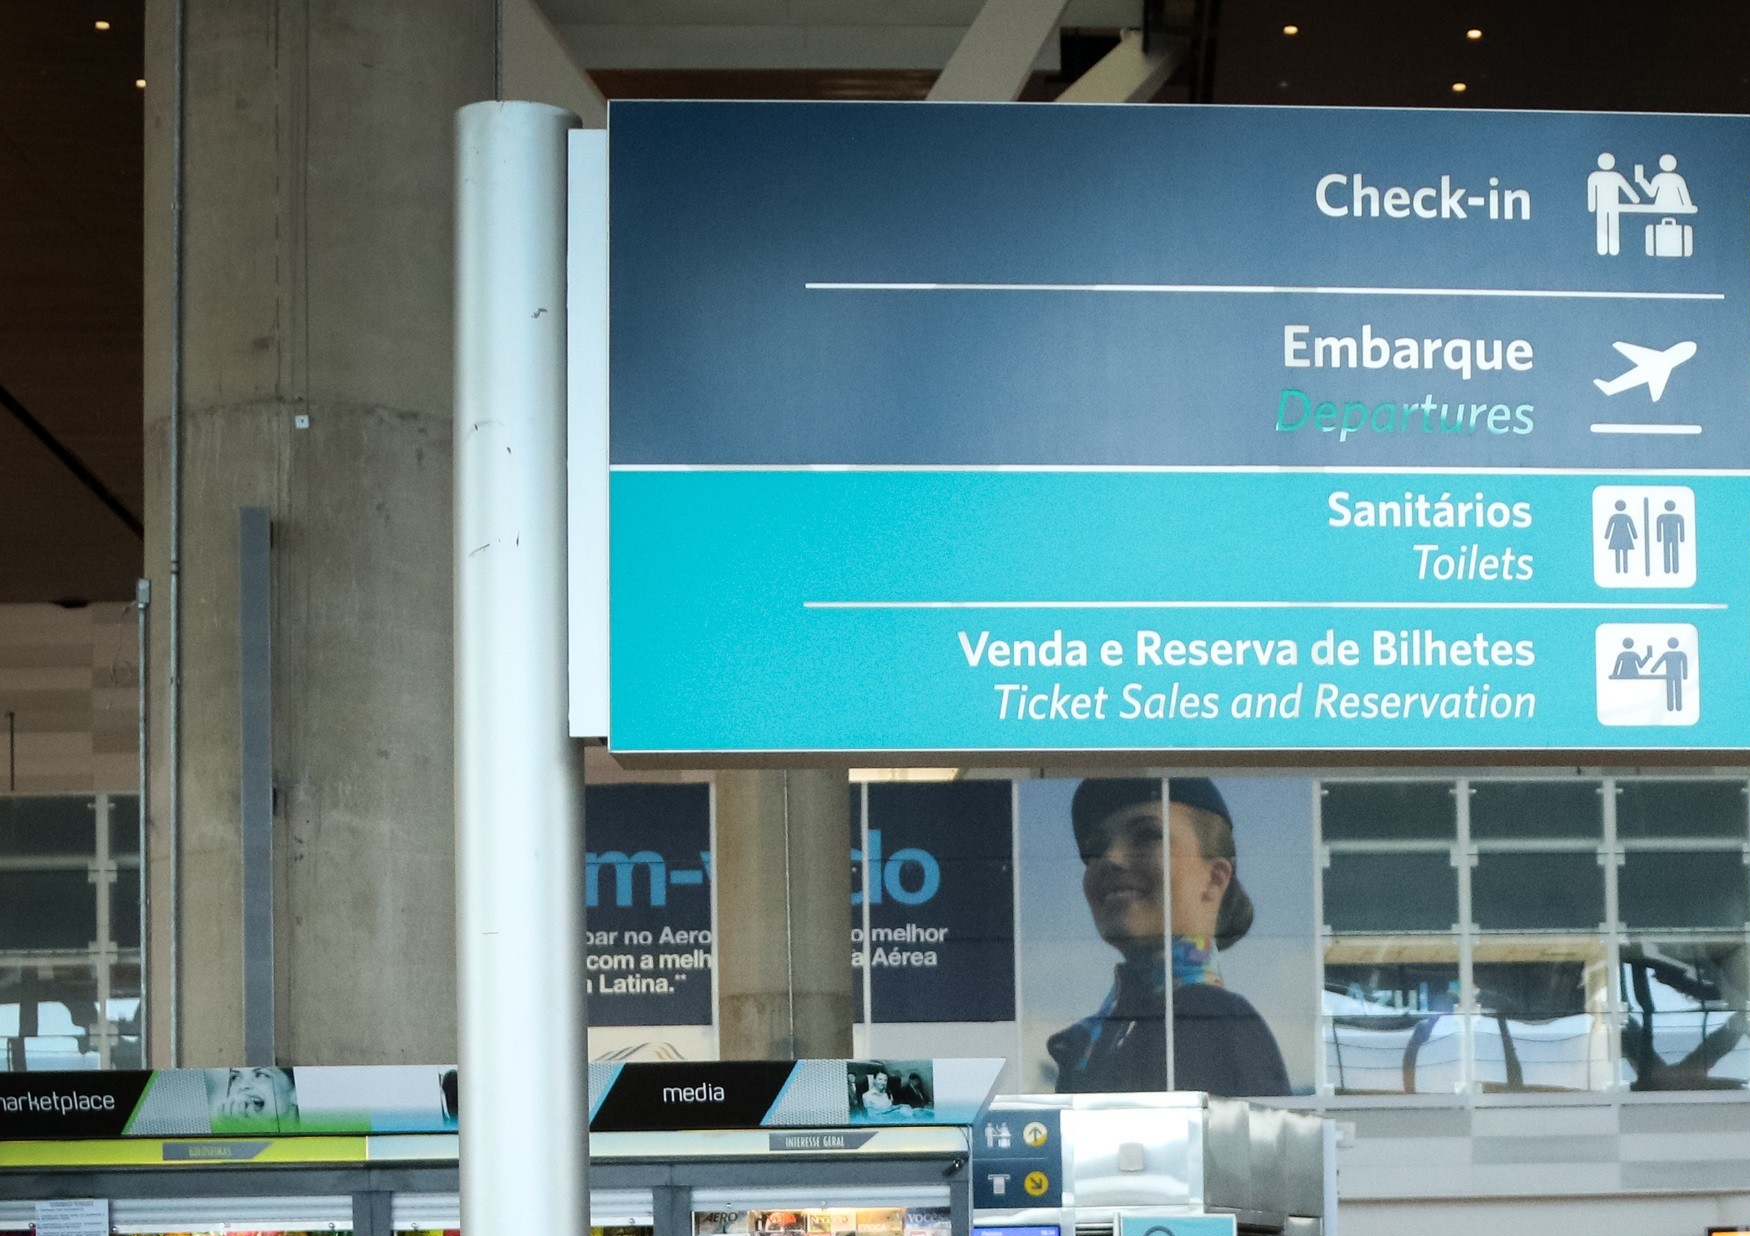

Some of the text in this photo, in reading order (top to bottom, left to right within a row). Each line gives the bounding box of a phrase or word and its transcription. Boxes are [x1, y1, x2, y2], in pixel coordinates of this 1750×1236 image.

[1315, 173, 1531, 220] Check-in
[1284, 323, 1534, 380] Embarque
[1275, 388, 1535, 443] Departures
[1328, 491, 1533, 528] Sanitários
[1413, 543, 1534, 580] Toilets
[957, 629, 1536, 667] Venda e Reserva de Bilhetes
[993, 681, 1536, 720] Ticket Sales and Reservation
[624, 930, 653, 945] no
[871, 923, 949, 942] melhor
[586, 954, 635, 970] com
[640, 954, 654, 969] a
[871, 946, 938, 967] Aérea
[662, 1083, 725, 1102] media
[785, 1135, 845, 1148] INTERESSE GERAL
